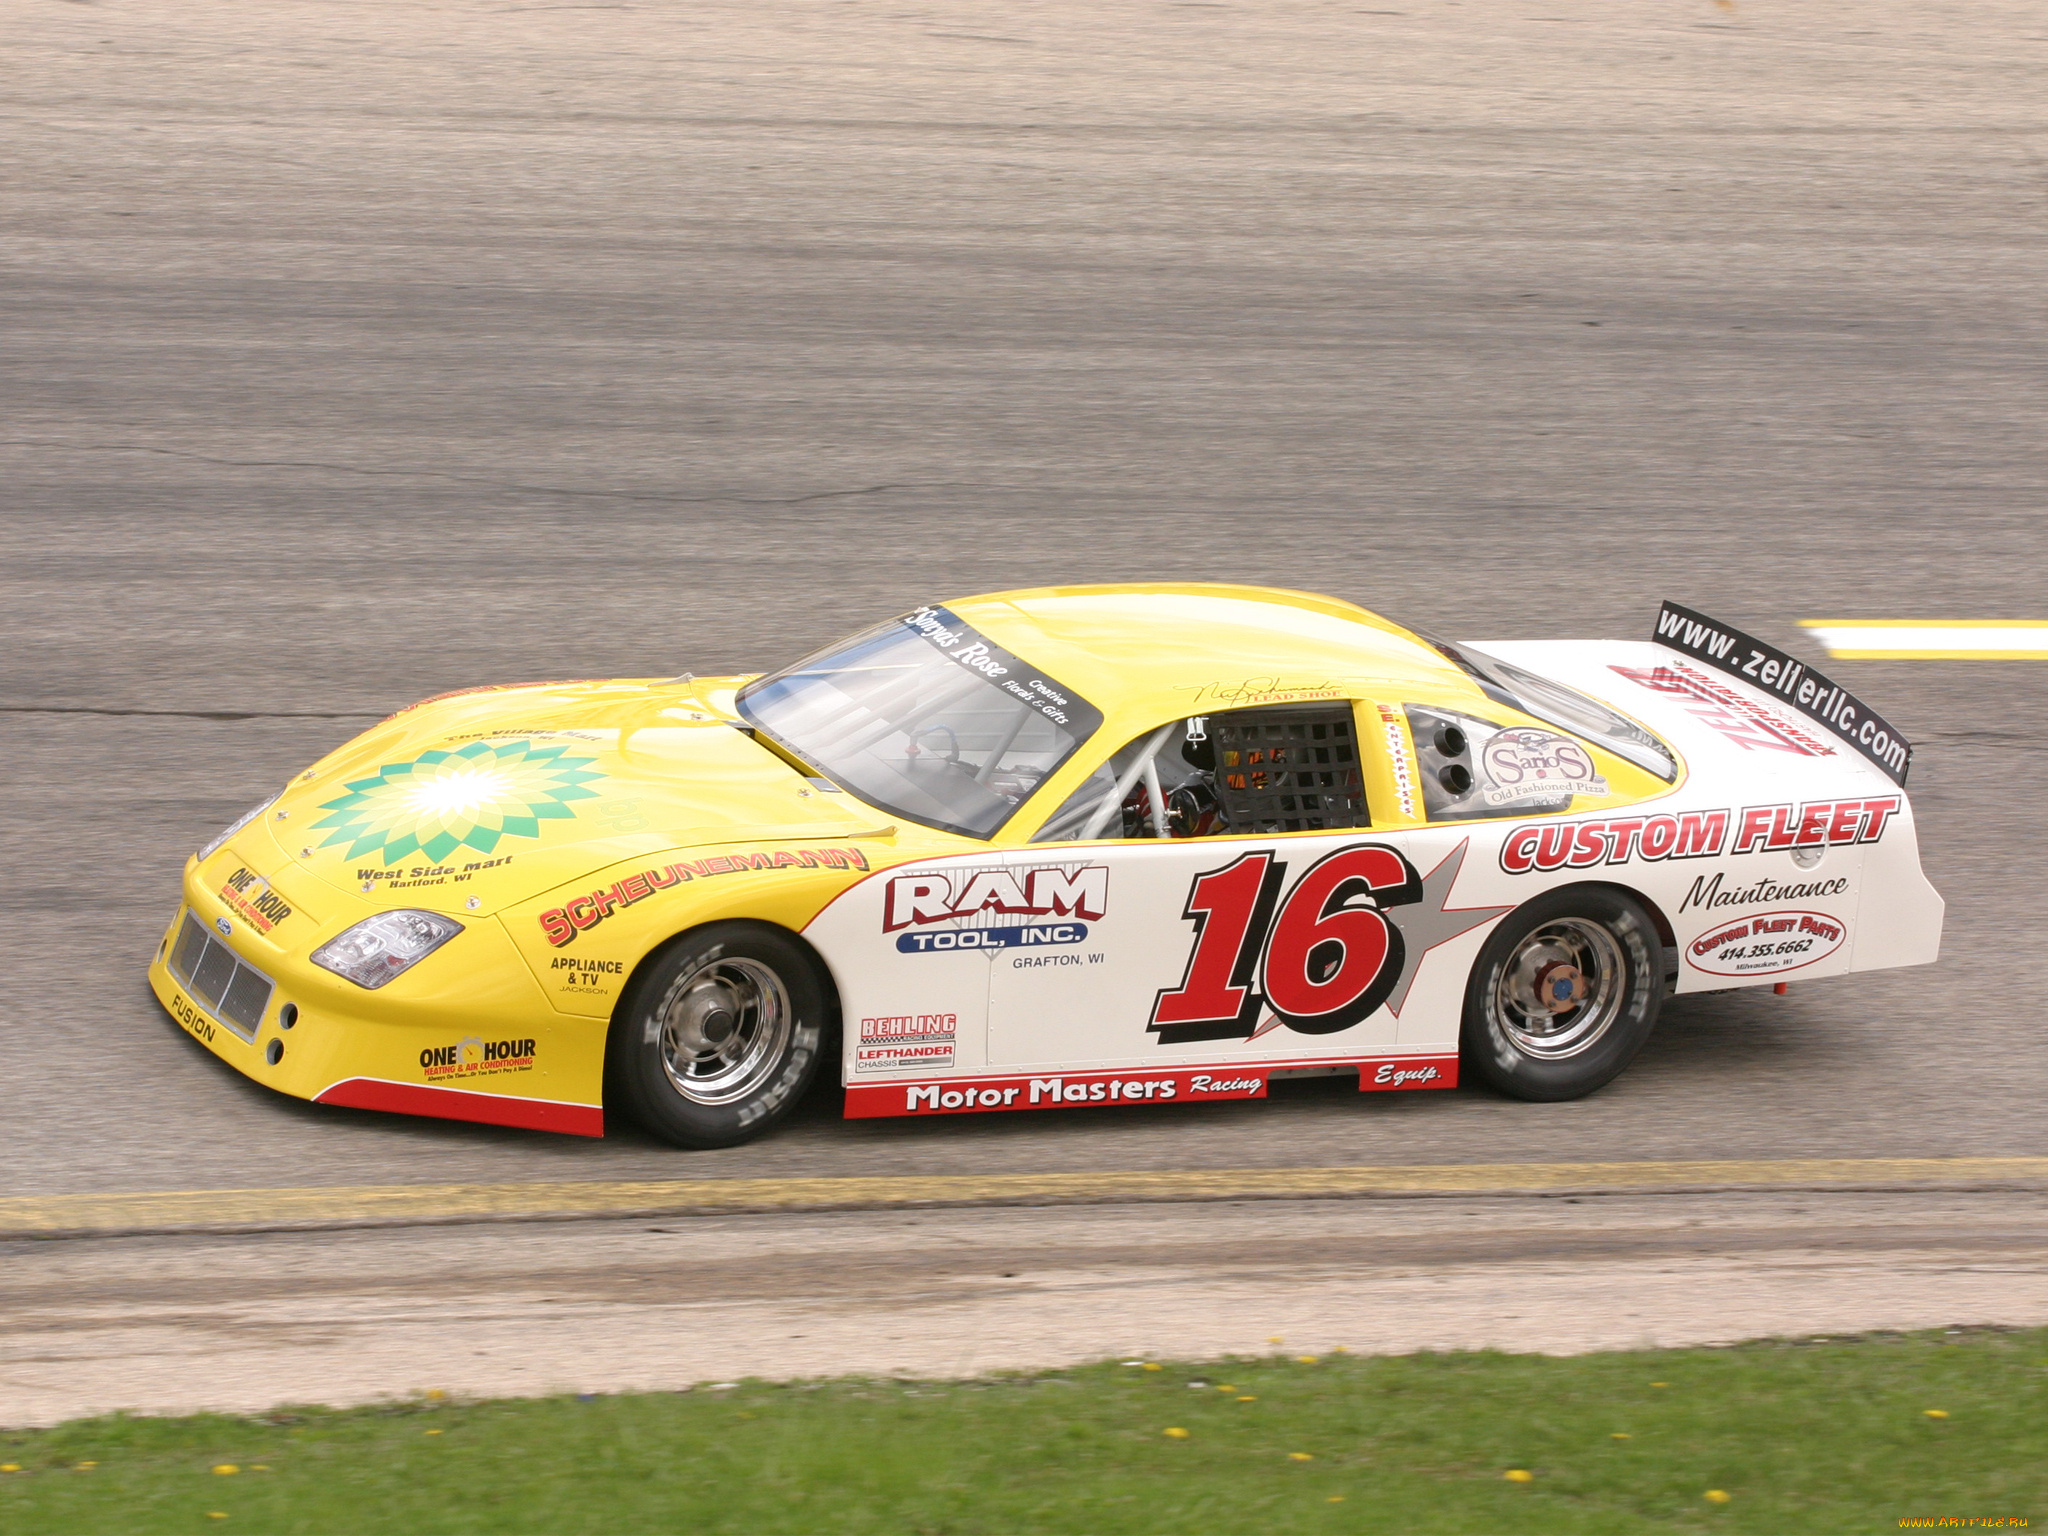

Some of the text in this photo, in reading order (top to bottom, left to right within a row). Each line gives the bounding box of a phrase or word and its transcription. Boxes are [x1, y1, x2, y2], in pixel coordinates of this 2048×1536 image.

[950, 641, 1008, 678] Rose
[1002, 680, 1068, 725] Florals & Gifts
[1029, 680, 1068, 706] Creative
[1254, 691, 1341, 702] LEAD SHOE
[1657, 609, 1907, 774] www.zellerllc.com
[1491, 782, 1605, 802] Old Fashioned Pizza
[1499, 795, 1901, 875] CUSTOM FLEET
[357, 855, 513, 880] West Side Mart
[454, 873, 472, 882] WI
[228, 867, 256, 893] ONE
[253, 889, 292, 926] HOUR
[537, 847, 870, 948] SCHEUNEMANN
[882, 866, 1109, 934] RAM
[1677, 872, 1849, 915] Maintenance
[913, 926, 1081, 950] TOOL, INC.
[1752, 918, 1798, 935] FLEET
[1799, 916, 1841, 942] PARTS
[1145, 841, 1424, 1045] 16
[1718, 938, 1813, 961] 414.355.6662
[551, 957, 623, 974] APPLIANCE
[1012, 953, 1104, 969] GRAFTON, WI
[1735, 958, 1793, 971] Milwaukee, WI
[559, 986, 608, 995] JACKSON
[568, 972, 599, 986] & TV
[172, 994, 216, 1042] FUSION
[861, 1014, 956, 1038] BEHLING
[420, 1039, 536, 1068] ONE HOUR
[858, 1059, 897, 1069] CHASSIS
[859, 1046, 953, 1060] LEFTHANDER
[424, 1057, 533, 1076] HEATING & AIR CONDITIONING
[906, 1064, 1442, 1111] Motor Masters Racing Equip.
